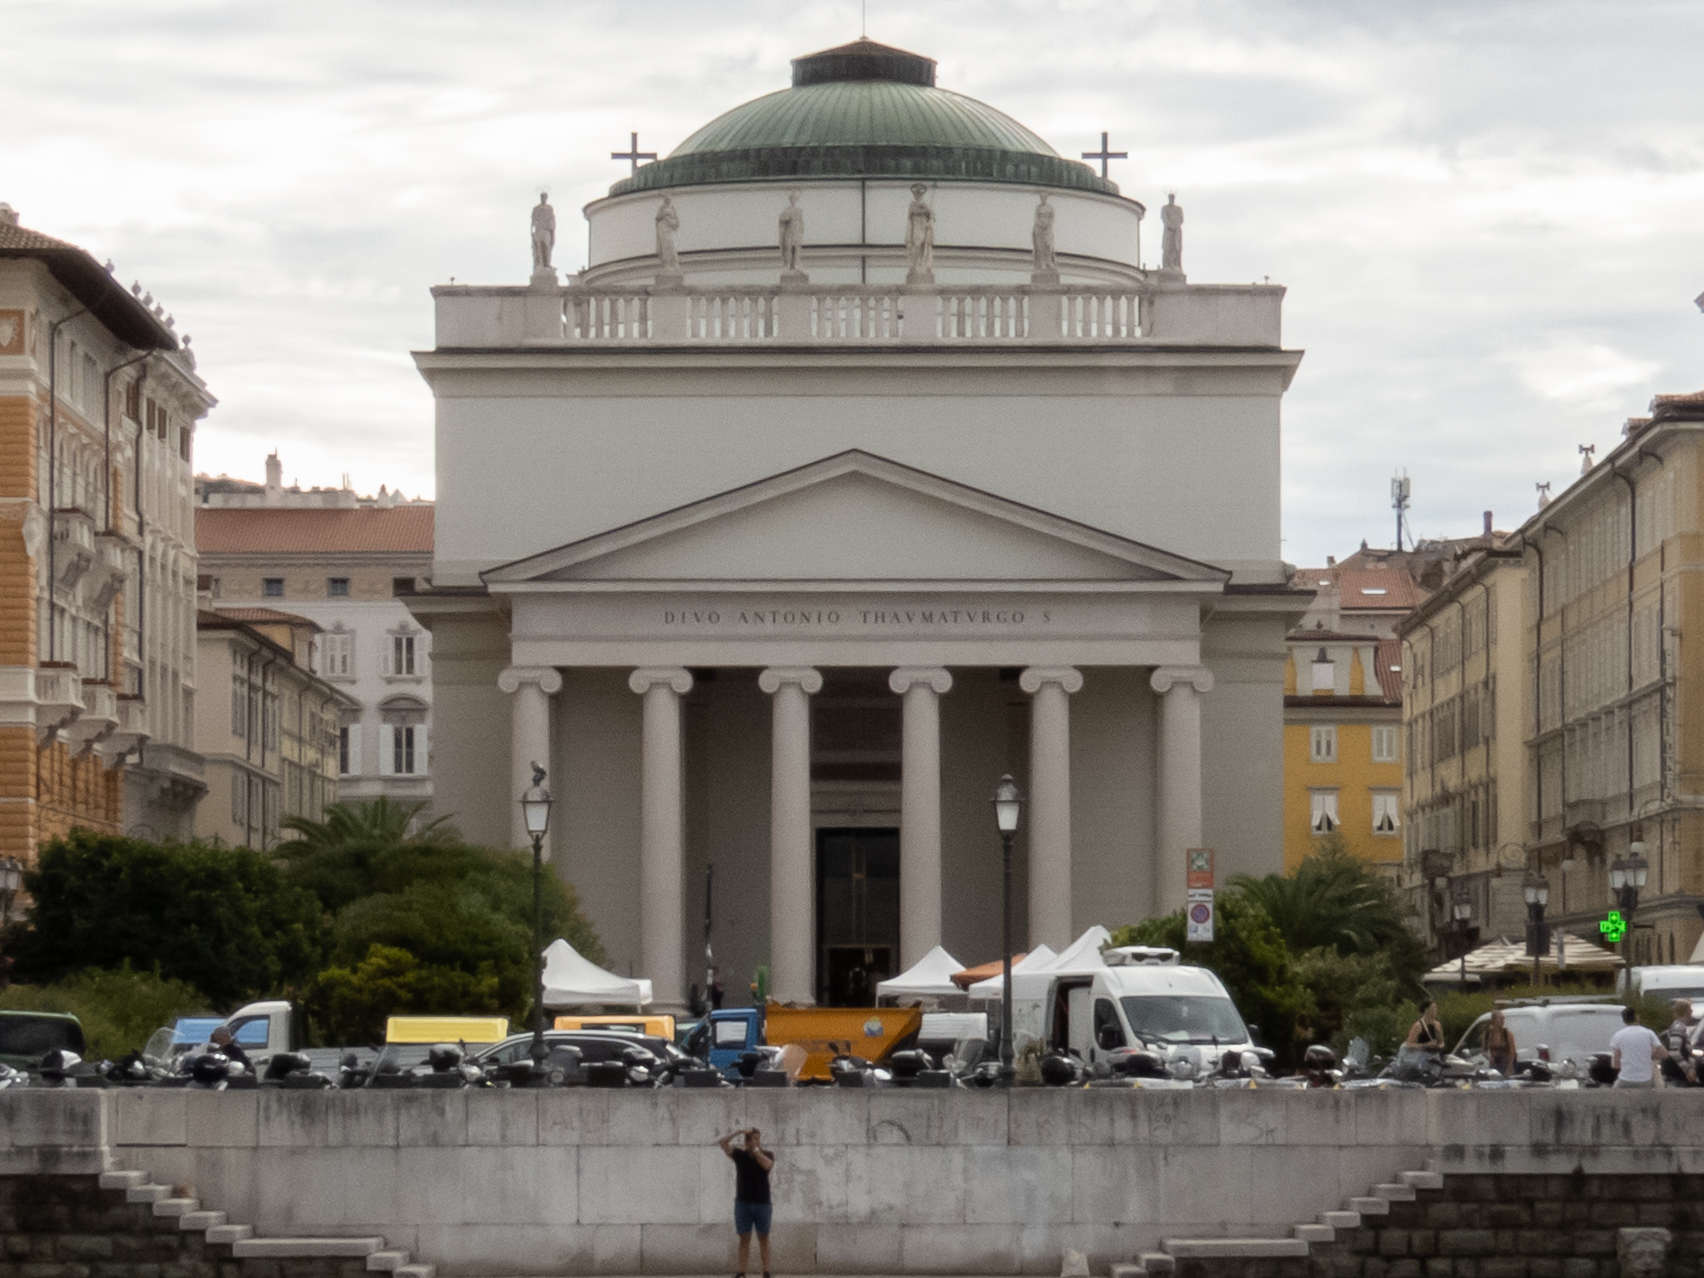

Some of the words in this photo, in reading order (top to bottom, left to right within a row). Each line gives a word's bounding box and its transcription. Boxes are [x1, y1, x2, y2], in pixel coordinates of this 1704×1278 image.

[664, 610, 721, 624] DIVO
[738, 610, 841, 624] ANTONIO
[859, 610, 1026, 624] THAVMATVRGO
